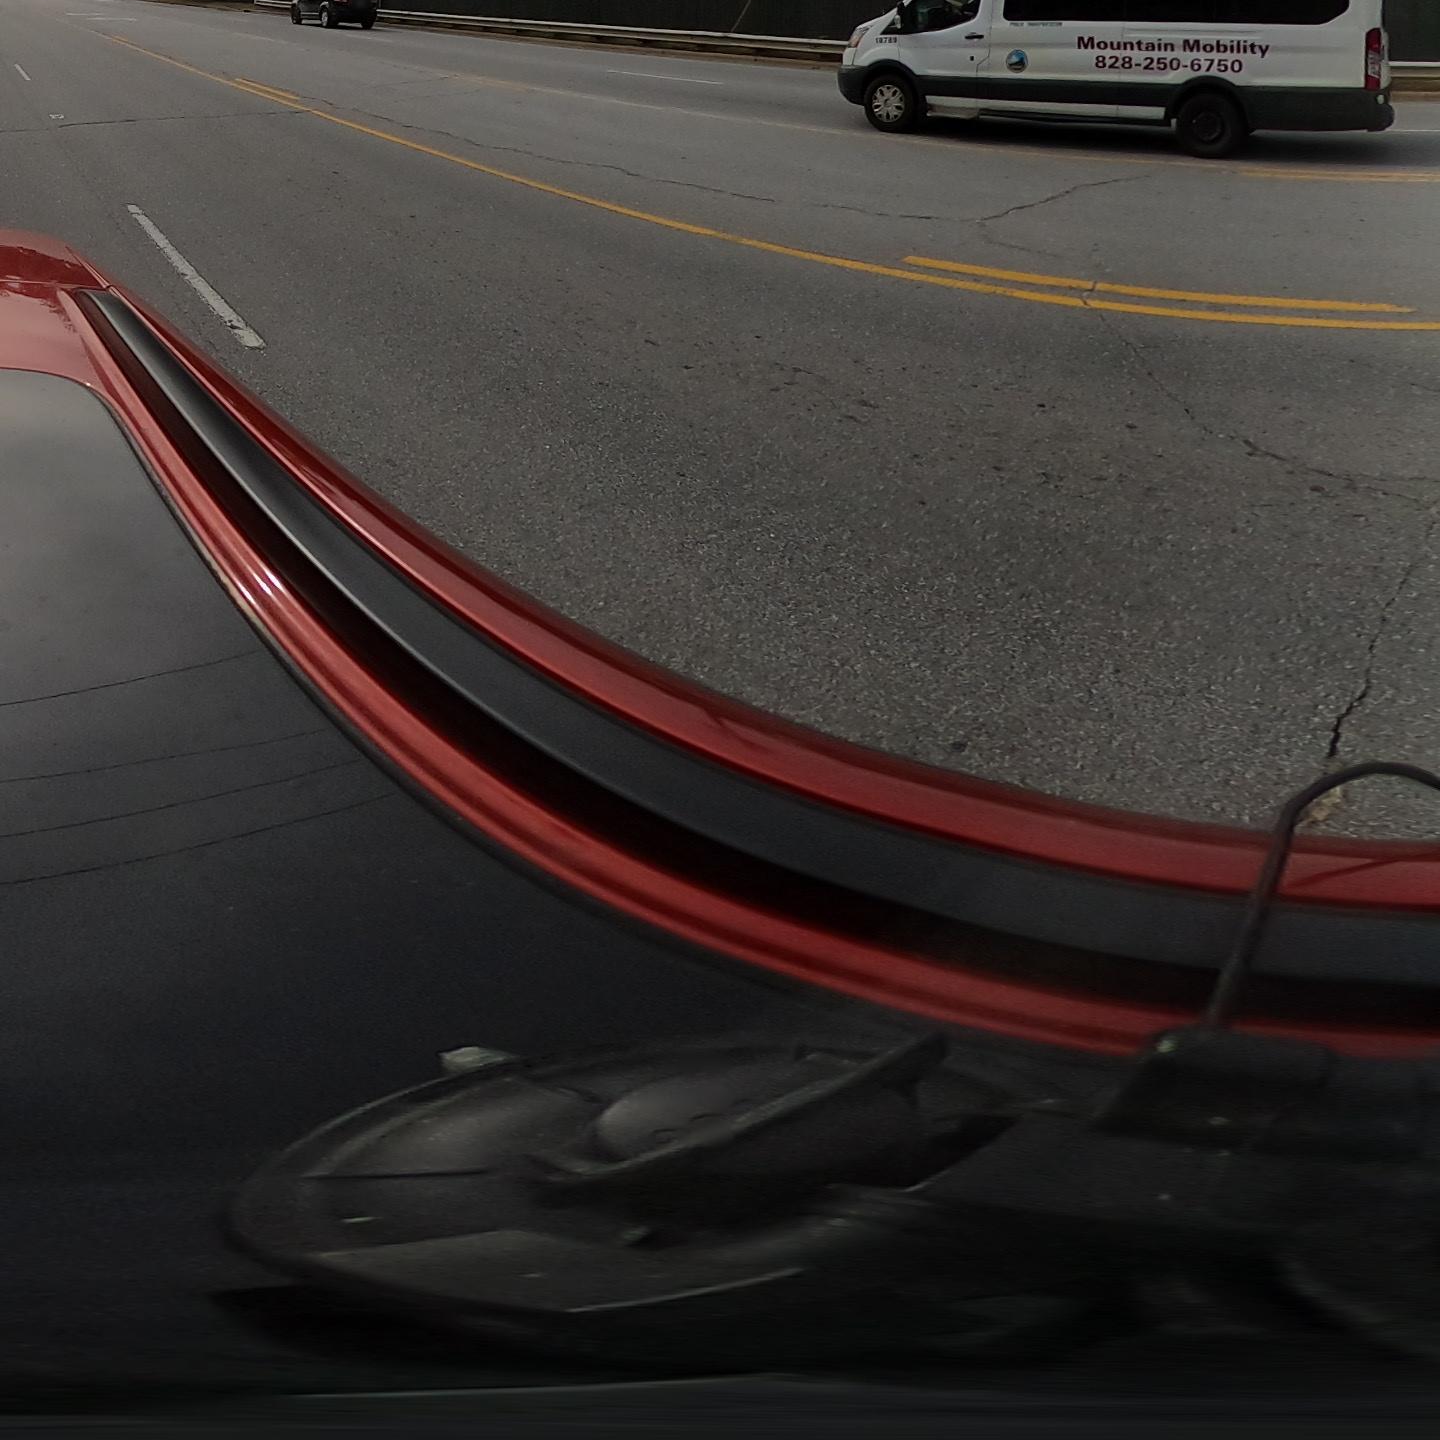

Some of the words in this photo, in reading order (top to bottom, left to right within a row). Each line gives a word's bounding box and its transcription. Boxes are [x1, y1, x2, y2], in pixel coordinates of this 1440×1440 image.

[1076, 35, 1175, 53] Mountain
[1182, 39, 1270, 59] Mobility
[1094, 55, 1243, 73] 828-250-6750
